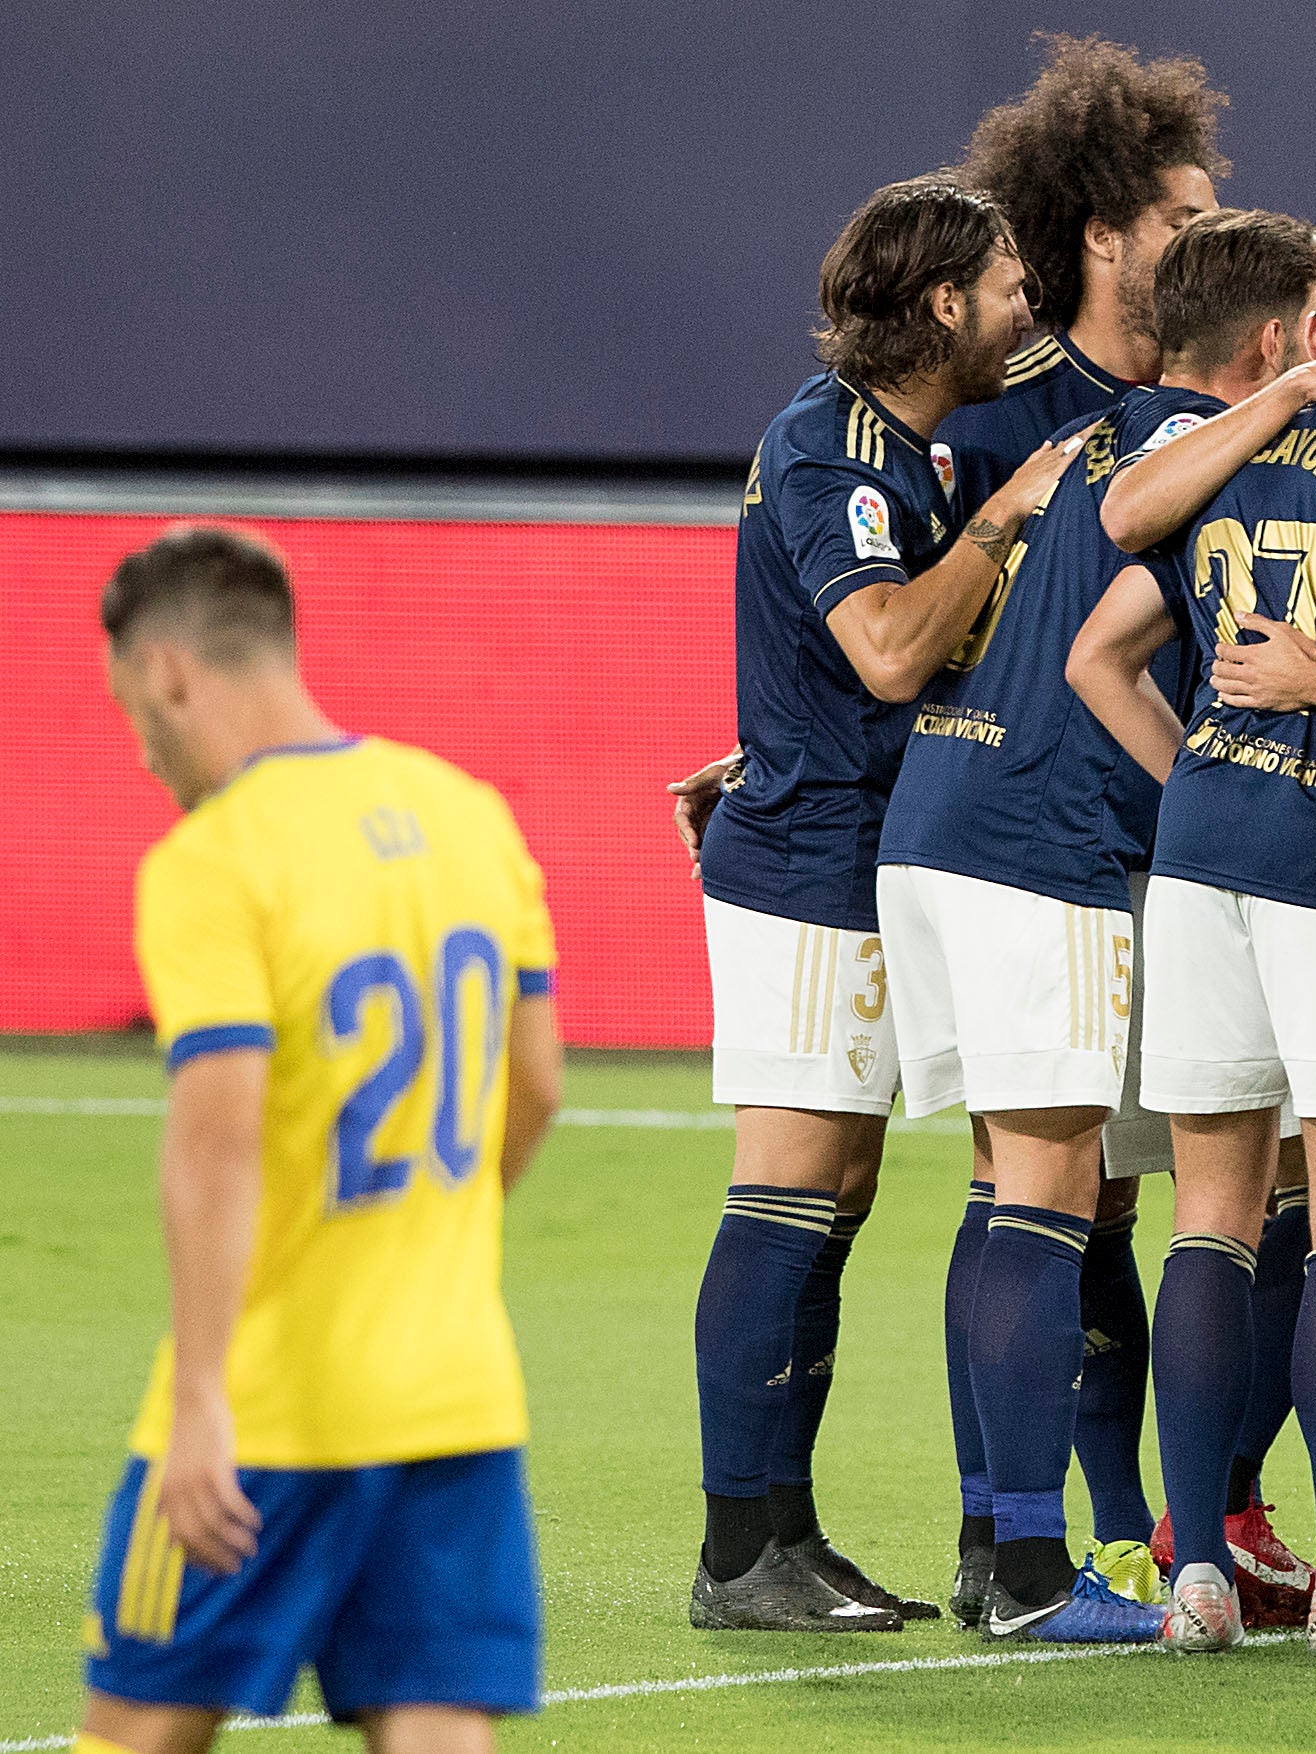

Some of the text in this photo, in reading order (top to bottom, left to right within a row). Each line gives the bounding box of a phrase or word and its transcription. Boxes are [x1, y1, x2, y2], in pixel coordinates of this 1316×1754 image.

[850, 936, 887, 1023] 3
[1111, 934, 1132, 1020] 5
[325, 926, 504, 1220] 20
